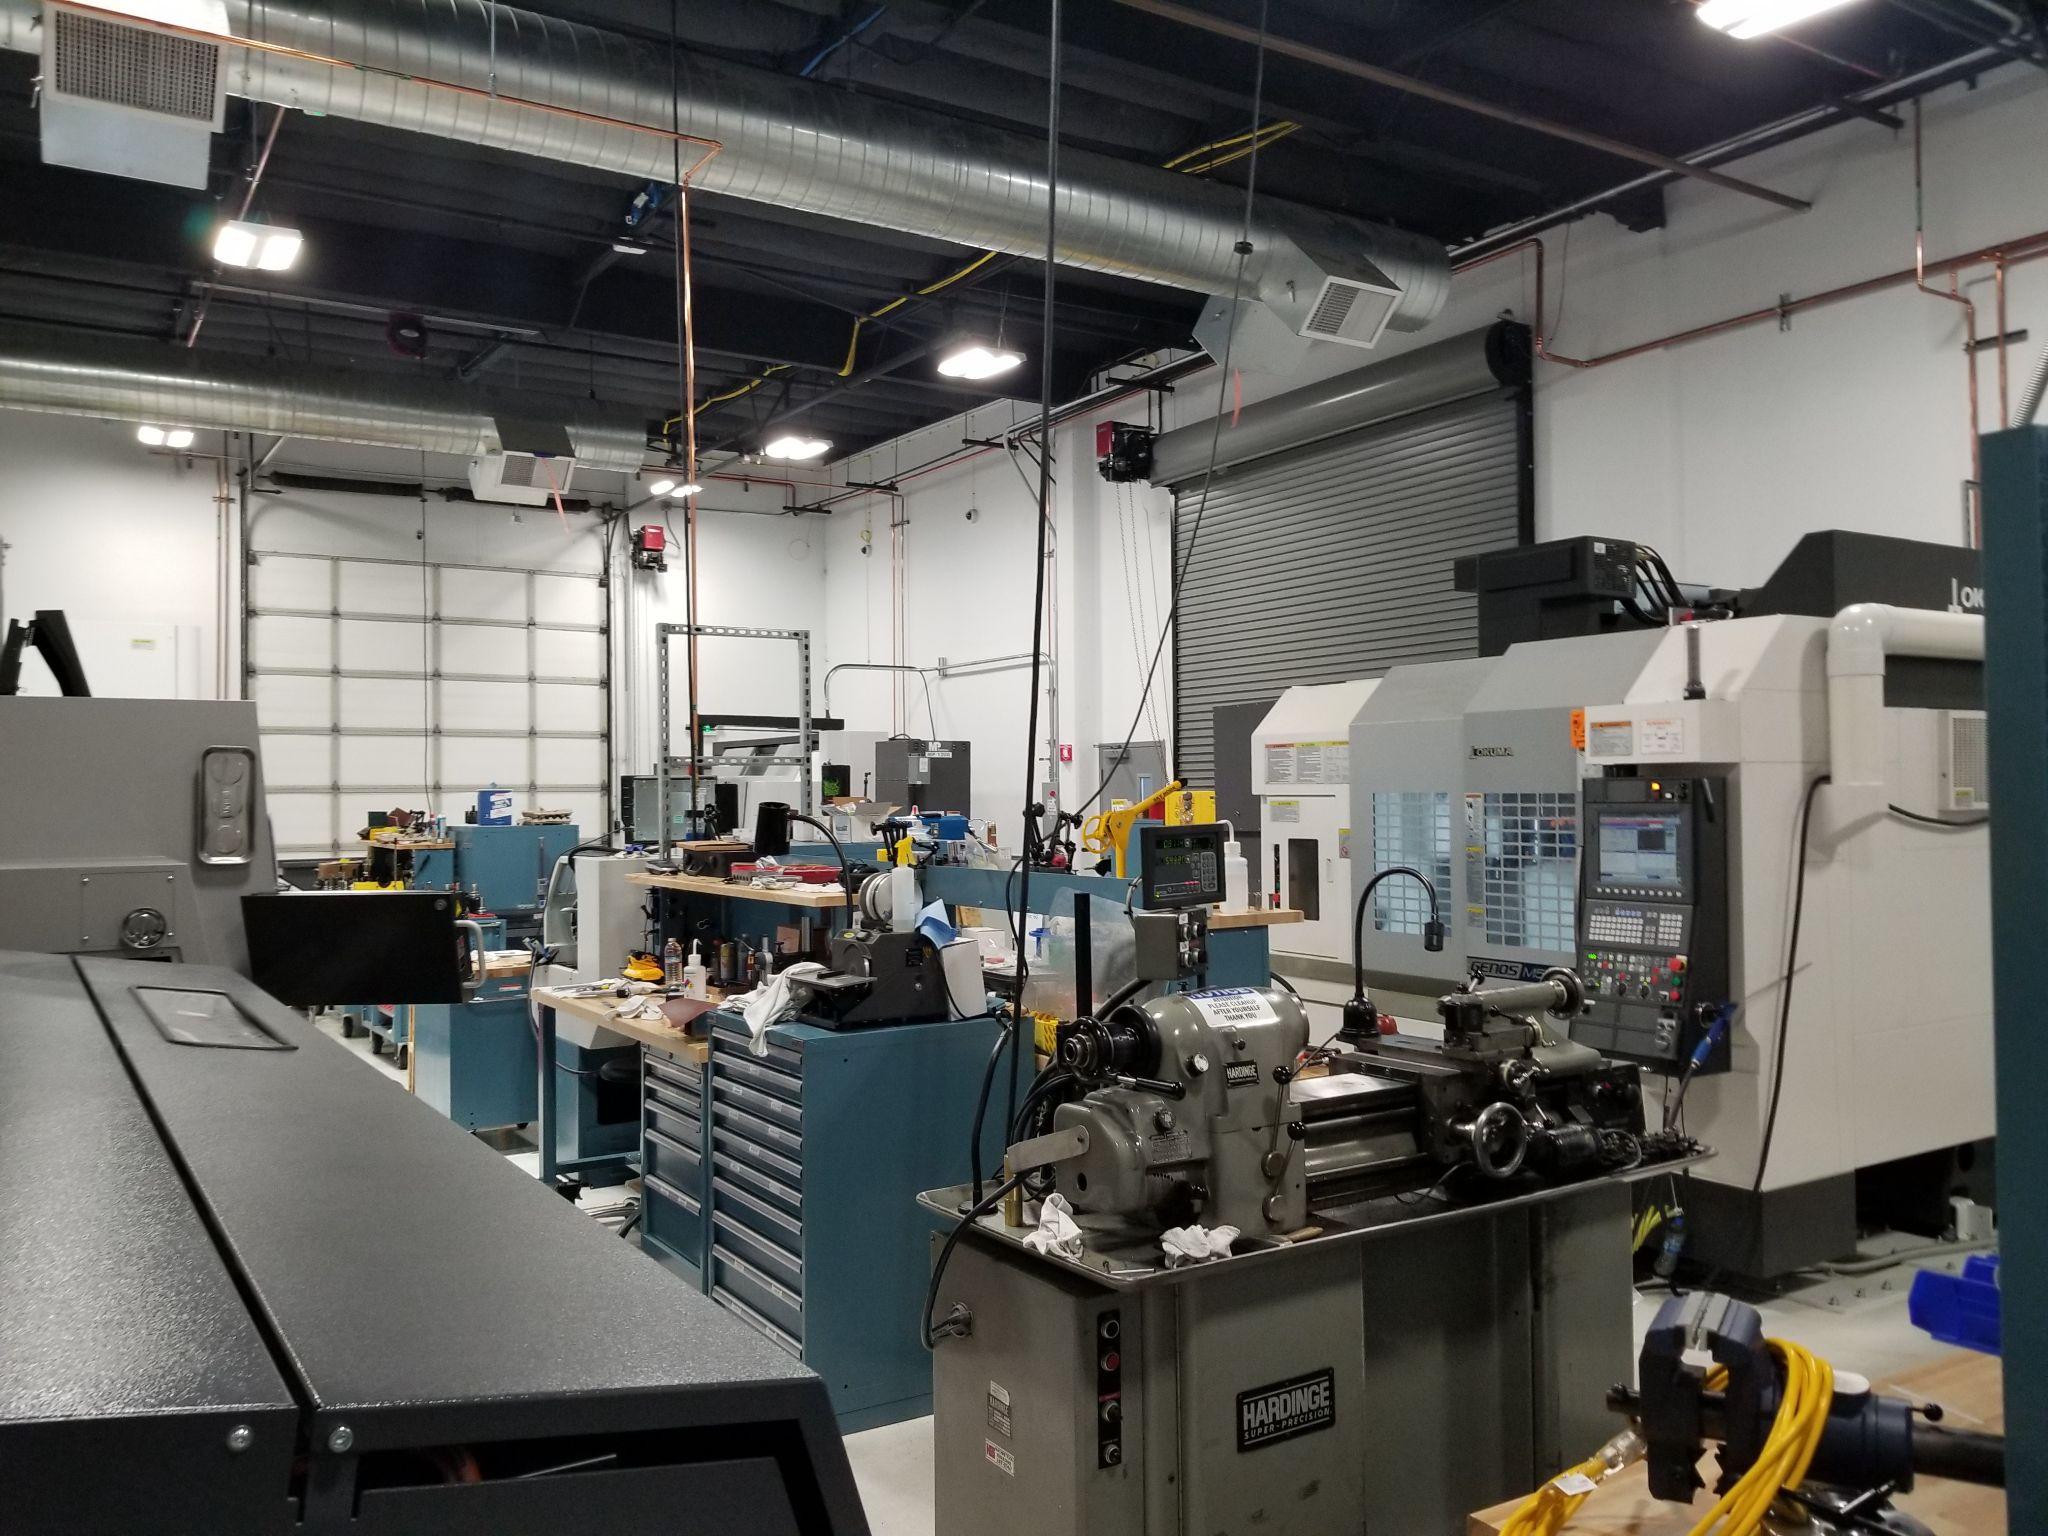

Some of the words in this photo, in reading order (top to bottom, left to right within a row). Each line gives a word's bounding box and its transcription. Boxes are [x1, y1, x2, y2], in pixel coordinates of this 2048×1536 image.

[1475, 747, 1513, 757] OKUMA
[1207, 1001, 1230, 1009] PLEASE
[1231, 999, 1257, 1007] CLEANUP
[1232, 1004, 1261, 1013] YOURSELF
[1226, 1064, 1257, 1079] HARDINGE
[1243, 1381, 1330, 1431] HARDINGE
